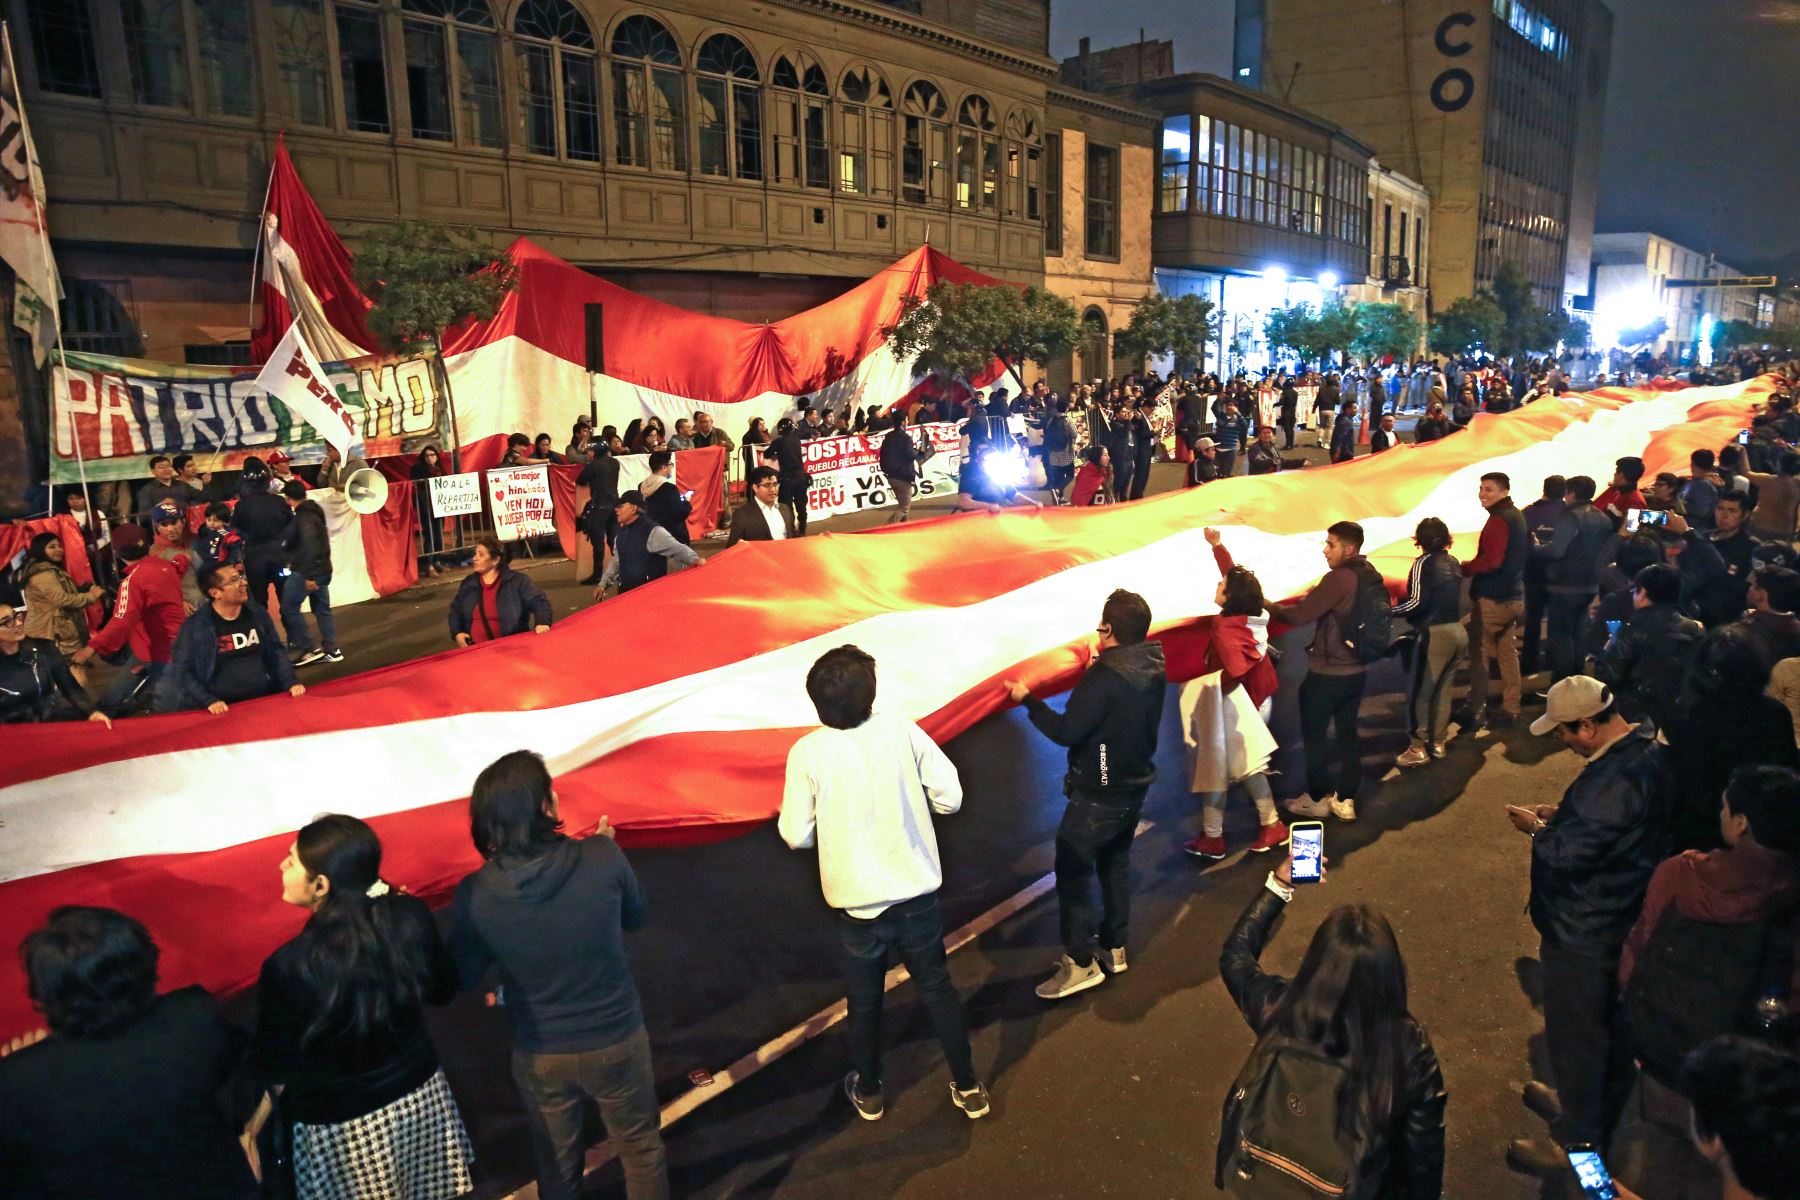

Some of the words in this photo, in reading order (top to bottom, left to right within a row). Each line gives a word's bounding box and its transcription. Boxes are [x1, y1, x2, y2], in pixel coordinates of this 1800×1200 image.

[53, 359, 434, 457] PATRIOSMO
[807, 460, 837, 473] PUEBLO
[521, 471, 540, 481] mejor
[434, 478, 448, 490] NO
[451, 480, 456, 488] A
[809, 485, 844, 510] ERÚ
[505, 499, 522, 511] VEN
[525, 498, 544, 509] HOY
[525, 509, 542, 521] POR
